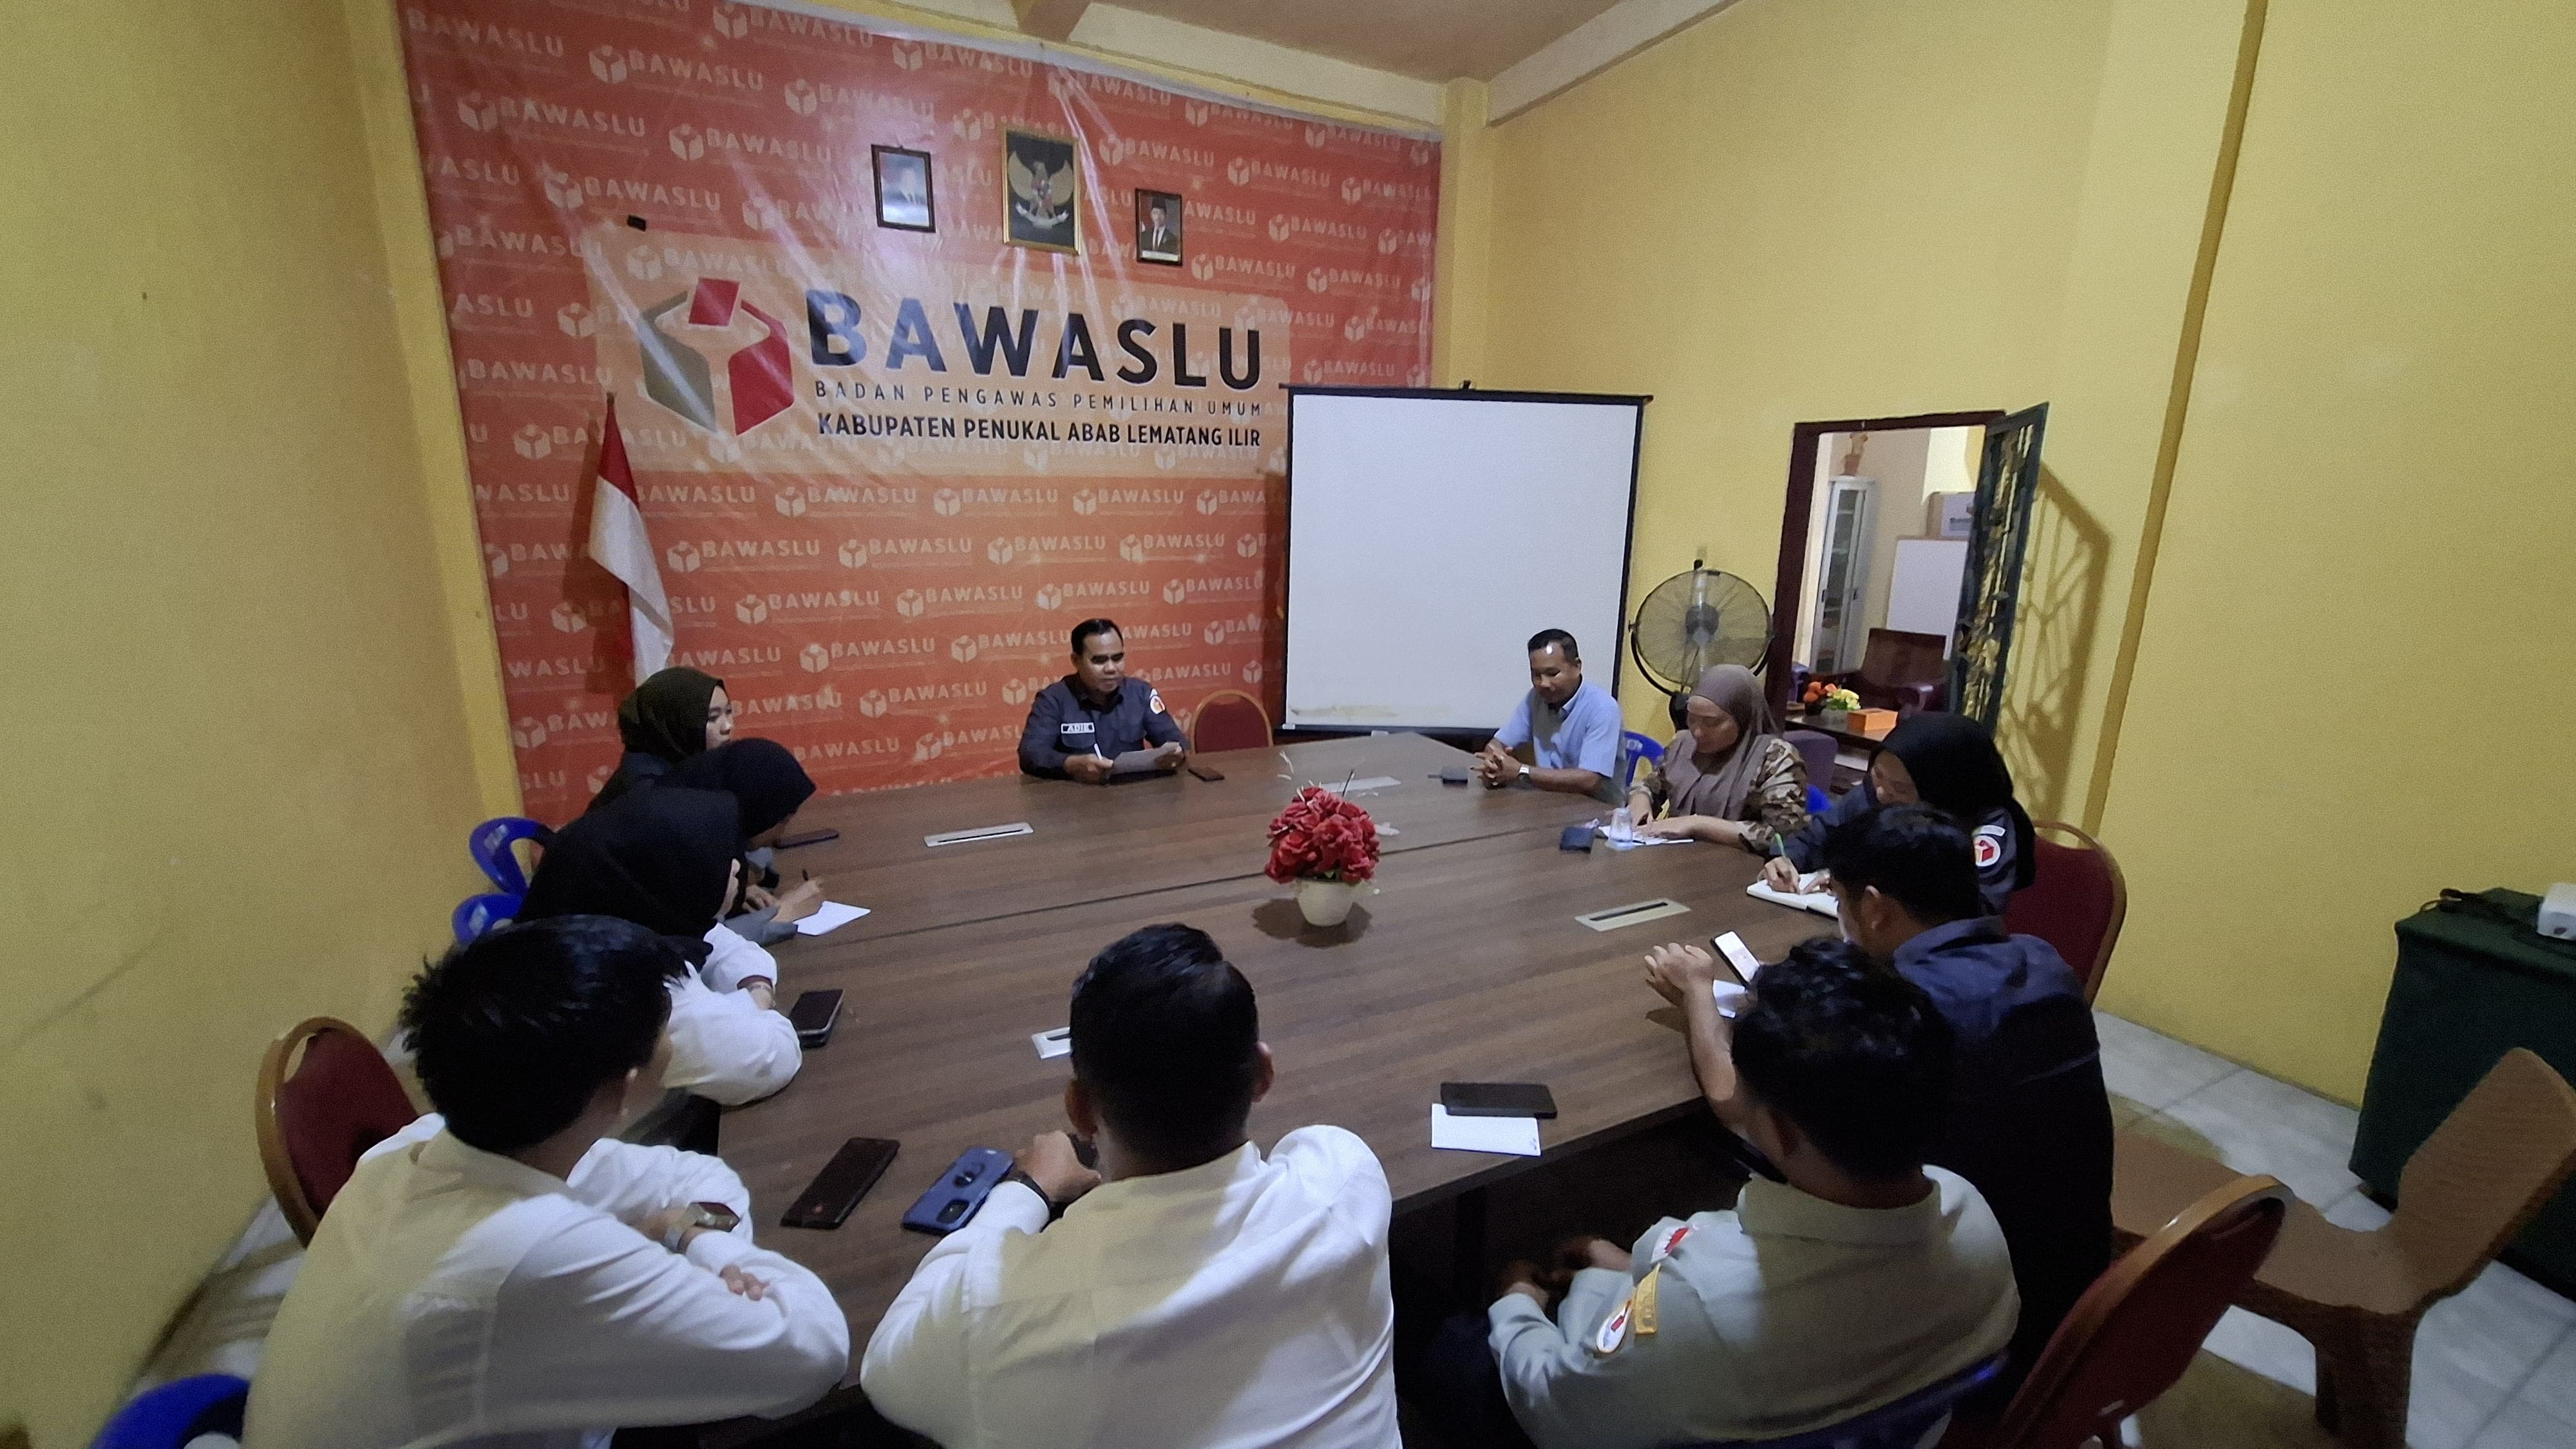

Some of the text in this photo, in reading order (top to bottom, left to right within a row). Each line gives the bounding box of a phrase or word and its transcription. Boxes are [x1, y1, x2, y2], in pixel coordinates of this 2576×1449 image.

[628, 48, 763, 91] BAWASLU
[500, 96, 645, 137] BAWASLU
[706, 128, 831, 163] BAWASLU
[1124, 137, 1215, 167] BAWASLU
[1251, 160, 1330, 188] BAWASLU
[585, 176, 721, 211] BAWASLU
[1184, 200, 1256, 225] AWASLU
[1291, 216, 1367, 240] BAWASLU
[1215, 255, 1296, 279] BAWASLU
[1329, 267, 1401, 289] BAWASLU
[806, 289, 1261, 390] BAWASLU
[1323, 359, 1396, 376] BAWASLU
[815, 380, 905, 401] BADAN
[925, 386, 1057, 408] PENGAWAS
[1074, 393, 1194, 414] PEMILIHAN
[1208, 400, 1261, 417] UMUM
[817, 413, 1261, 448] KABUPATEN PENUKAL ABAB LEMATANG ILIR
[808, 486, 916, 504] BAWASLU
[962, 488, 1059, 504] BAWASLU
[1097, 489, 1184, 505] BAWASLU
[701, 539, 821, 558] BAWASLU
[869, 538, 973, 554] BAWASLU
[1014, 535, 1106, 552] BAWASLU
[1142, 533, 1225, 549] BAWASLU
[925, 585, 1023, 604] BAWASLU
[1063, 580, 1150, 598] BAWASLU
[768, 590, 880, 611] BAWASLU
[978, 629, 1071, 650] BAWASLU
[1120, 622, 1192, 640] AWASLU
[831, 637, 936, 659] BAWASLU
[1151, 662, 1231, 682] BAWASLU
[888, 680, 987, 703] BAWASLU
[793, 737, 900, 761] BAWASLU
